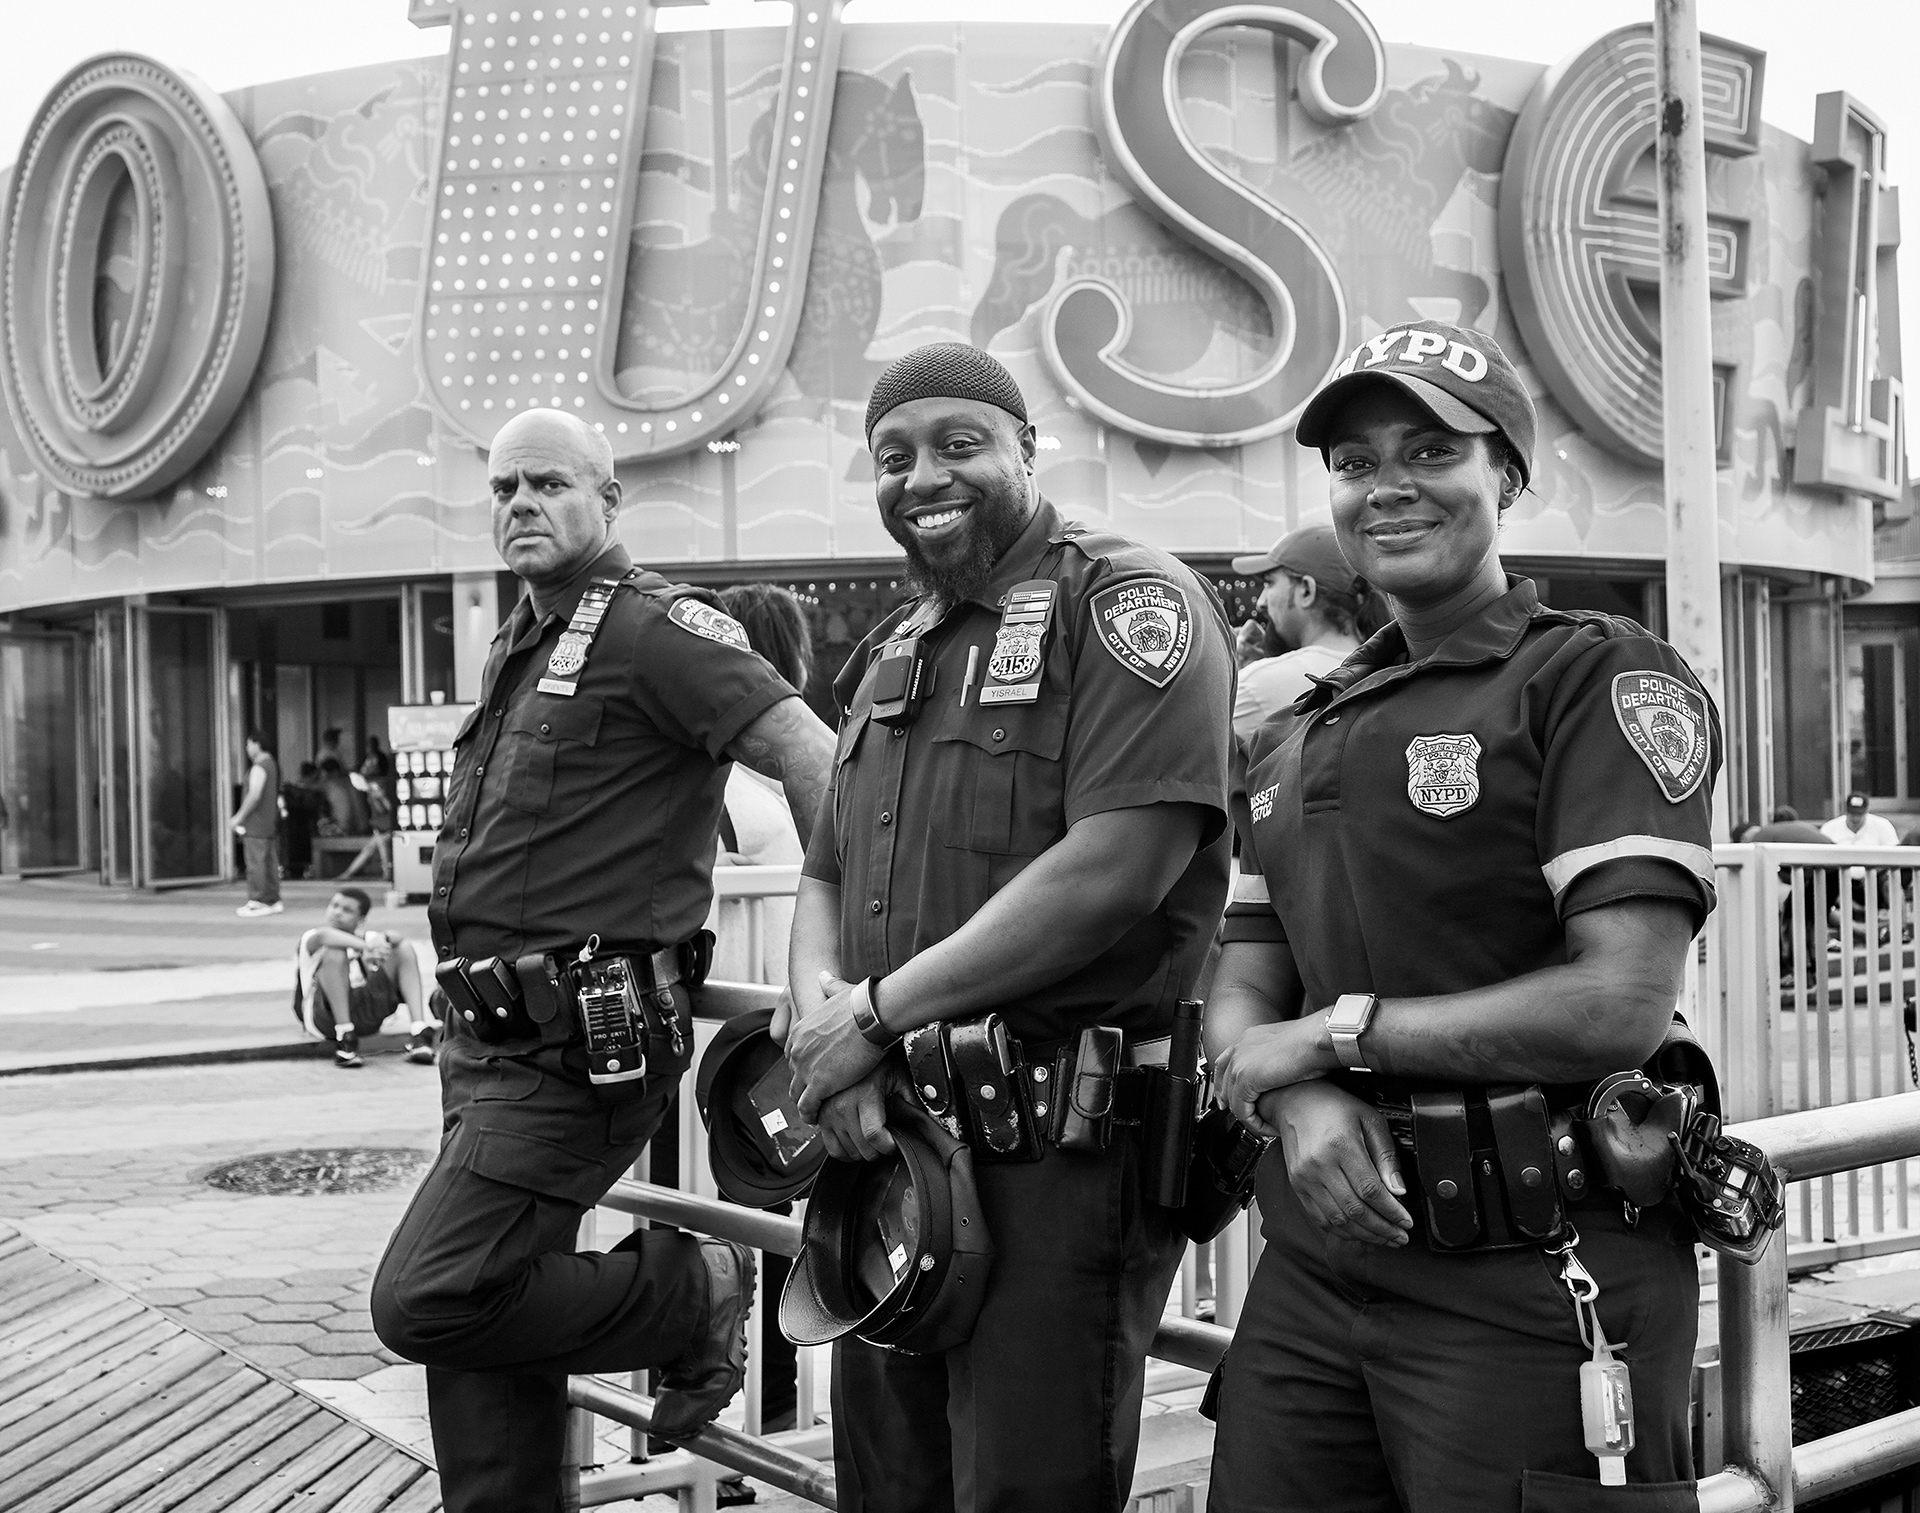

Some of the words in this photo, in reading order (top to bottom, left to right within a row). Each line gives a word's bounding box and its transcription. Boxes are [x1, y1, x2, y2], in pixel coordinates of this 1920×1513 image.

[1118, 585, 1165, 602] POLICE
[1104, 596, 1182, 622] DEPARTMENT
[1107, 632, 1131, 656] CITY
[1128, 655, 1147, 669] OF
[1163, 648, 1182, 672] NEW
[1176, 619, 1188, 649] YORK
[991, 655, 1033, 677] 24158
[991, 688, 1027, 698] YISRAEL
[1639, 678, 1687, 703] POLICE
[1621, 692, 1702, 726] DEPARTMENT
[1628, 723, 1654, 752] CITY
[1652, 755, 1668, 774] OF
[1678, 763, 1697, 787] NEW
[1692, 733, 1705, 765] YORK
[1420, 787, 1467, 802] NYPD
[594, 1031, 626, 1040] PROERTY
